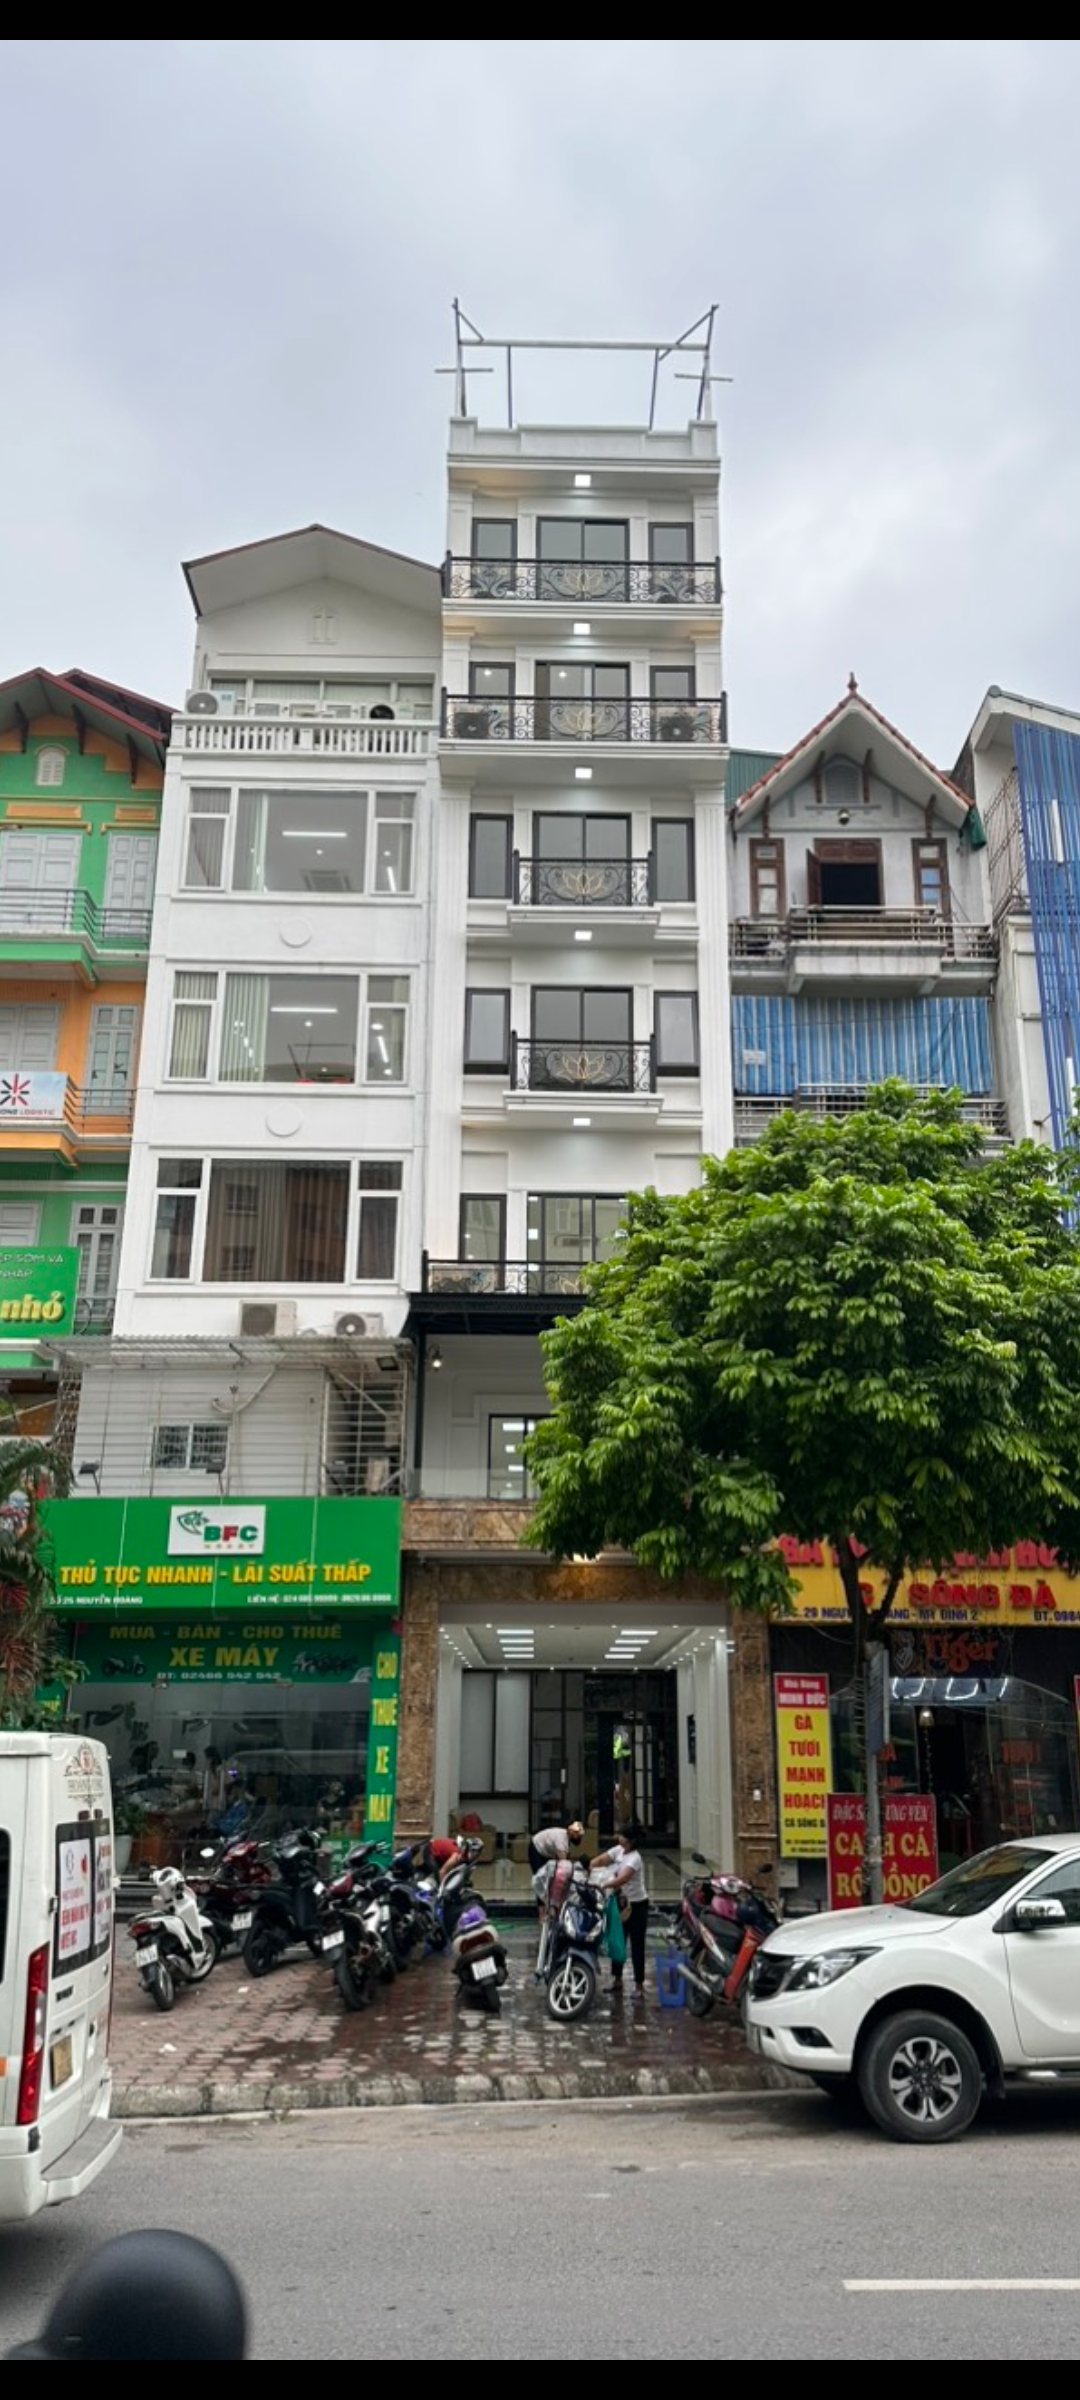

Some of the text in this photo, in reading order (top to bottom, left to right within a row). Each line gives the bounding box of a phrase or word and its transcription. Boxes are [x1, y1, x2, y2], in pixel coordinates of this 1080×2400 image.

[0, 1291, 64, 1320] nhỏ
[204, 1526, 258, 1541] BFC
[60, 1559, 97, 1584] THỦ
[103, 1565, 141, 1588] TỤC
[146, 1565, 213, 1584] NHANH
[233, 1560, 263, 1583] LÃI
[269, 1558, 317, 1583] SUẤT
[322, 1557, 371, 1583] THẤP
[908, 1578, 1000, 1609] SÔNG
[1009, 1579, 1057, 1609] ĐÀ
[109, 1626, 156, 1639] MUA
[177, 1624, 221, 1639] BÁN
[242, 1626, 284, 1639] CHO
[292, 1624, 342, 1639] THUÊ
[169, 1643, 279, 1667] XE MÁY
[376, 1652, 398, 1679] CHO
[794, 1712, 814, 1731] GÀ
[375, 1746, 389, 1773] XE
[789, 1738, 820, 1757] TƯƠI
[786, 1767, 826, 1786] MẠNH
[368, 1787, 393, 1822] MÁY
[835, 1826, 931, 1857] CAH CÁ
